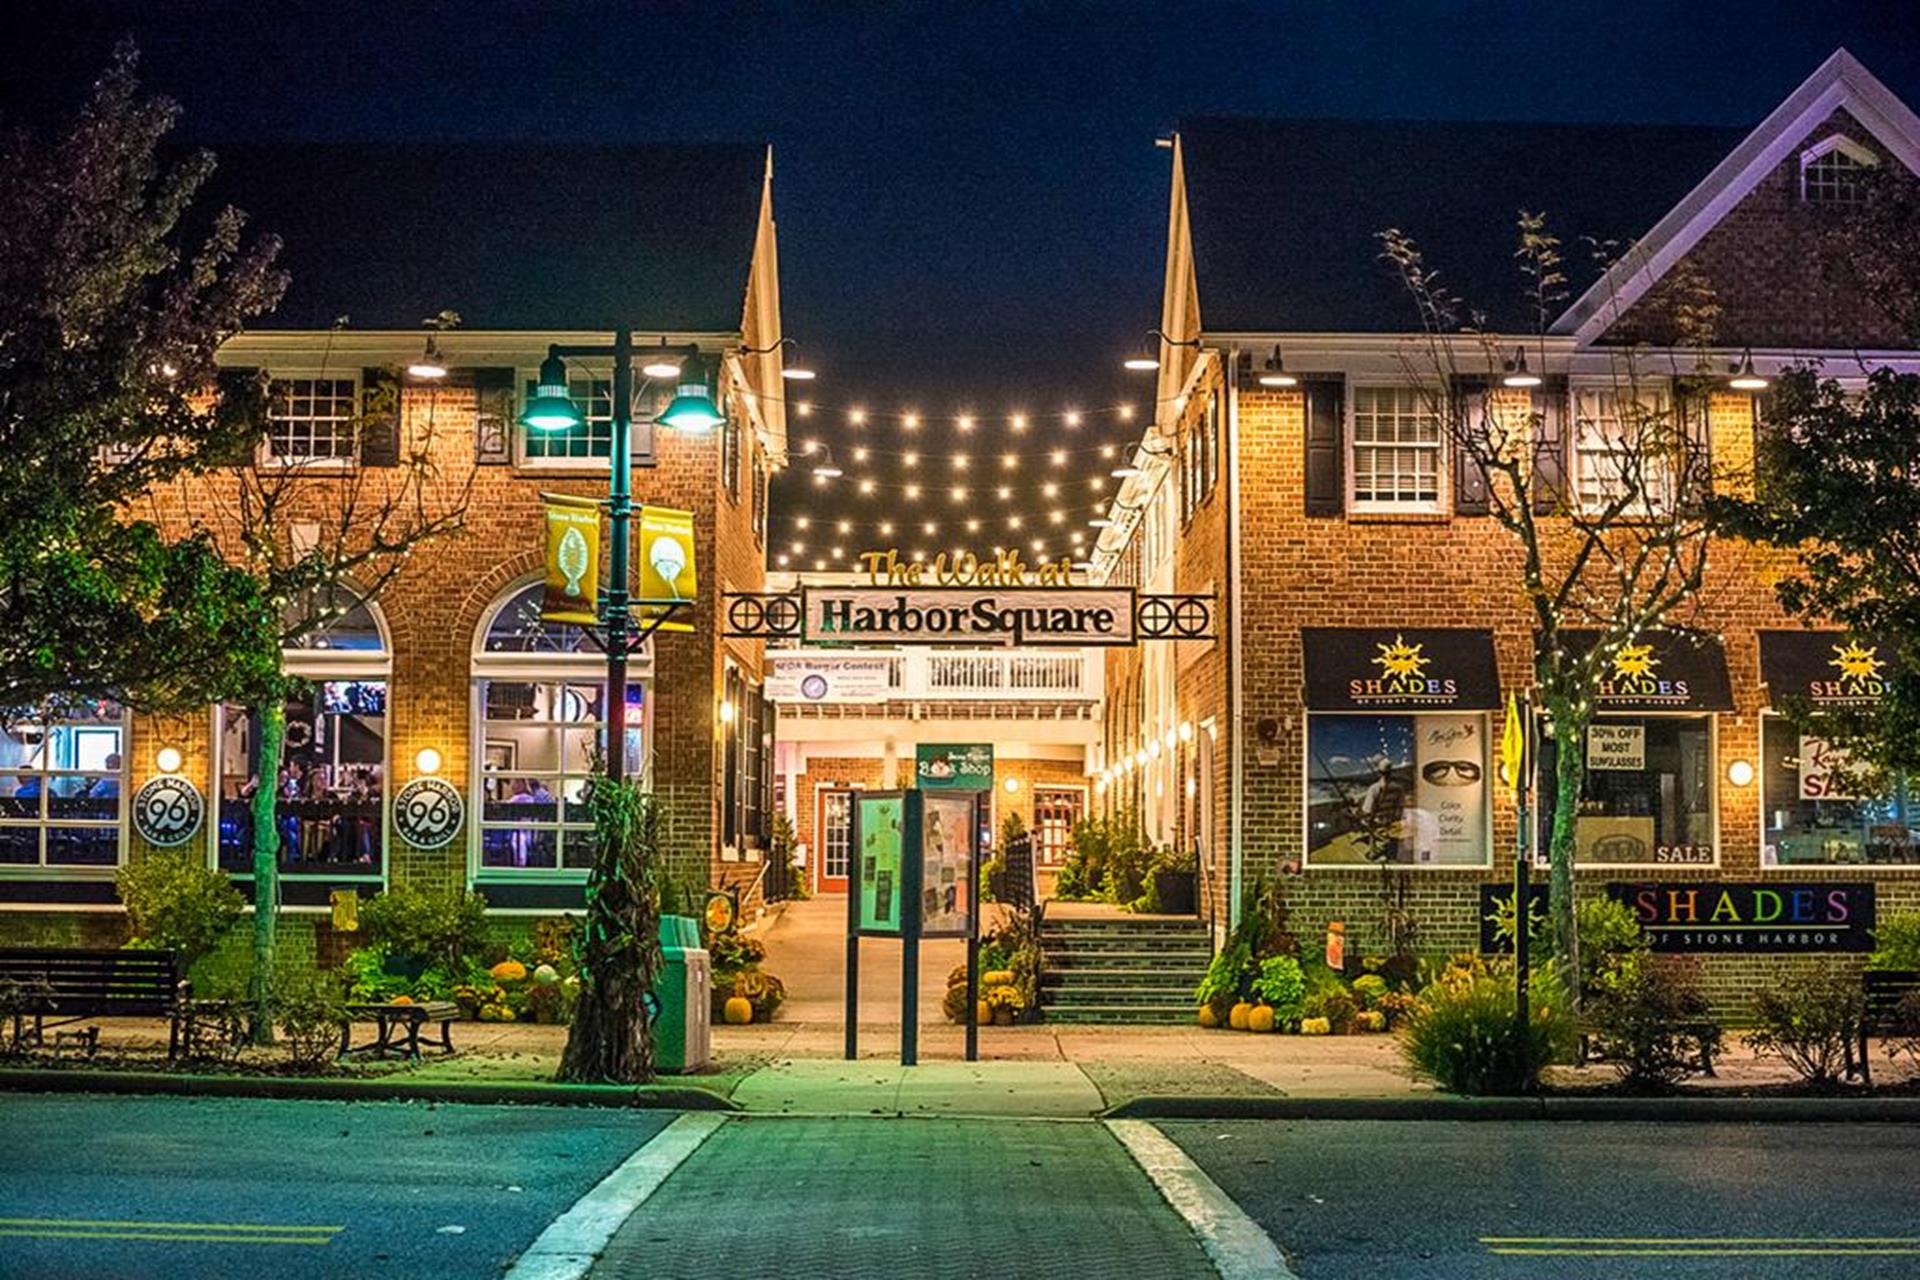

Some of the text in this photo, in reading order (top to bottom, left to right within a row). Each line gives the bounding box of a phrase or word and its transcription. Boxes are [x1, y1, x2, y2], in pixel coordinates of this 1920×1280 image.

[860, 549, 1074, 587] The Walk at
[1350, 679, 1457, 694] SHADES
[1599, 680, 1689, 694] HADES
[1810, 680, 1891, 695] SHAD
[1618, 728, 1641, 738] OFF
[1602, 742, 1631, 752] MOST
[150, 792, 186, 829] 96
[409, 797, 446, 831] 96
[1657, 847, 1711, 862] SALE
[1637, 890, 1849, 922] SHADES
[1684, 932, 1744, 945] STONE
[1759, 932, 1839, 944] HARBOR
